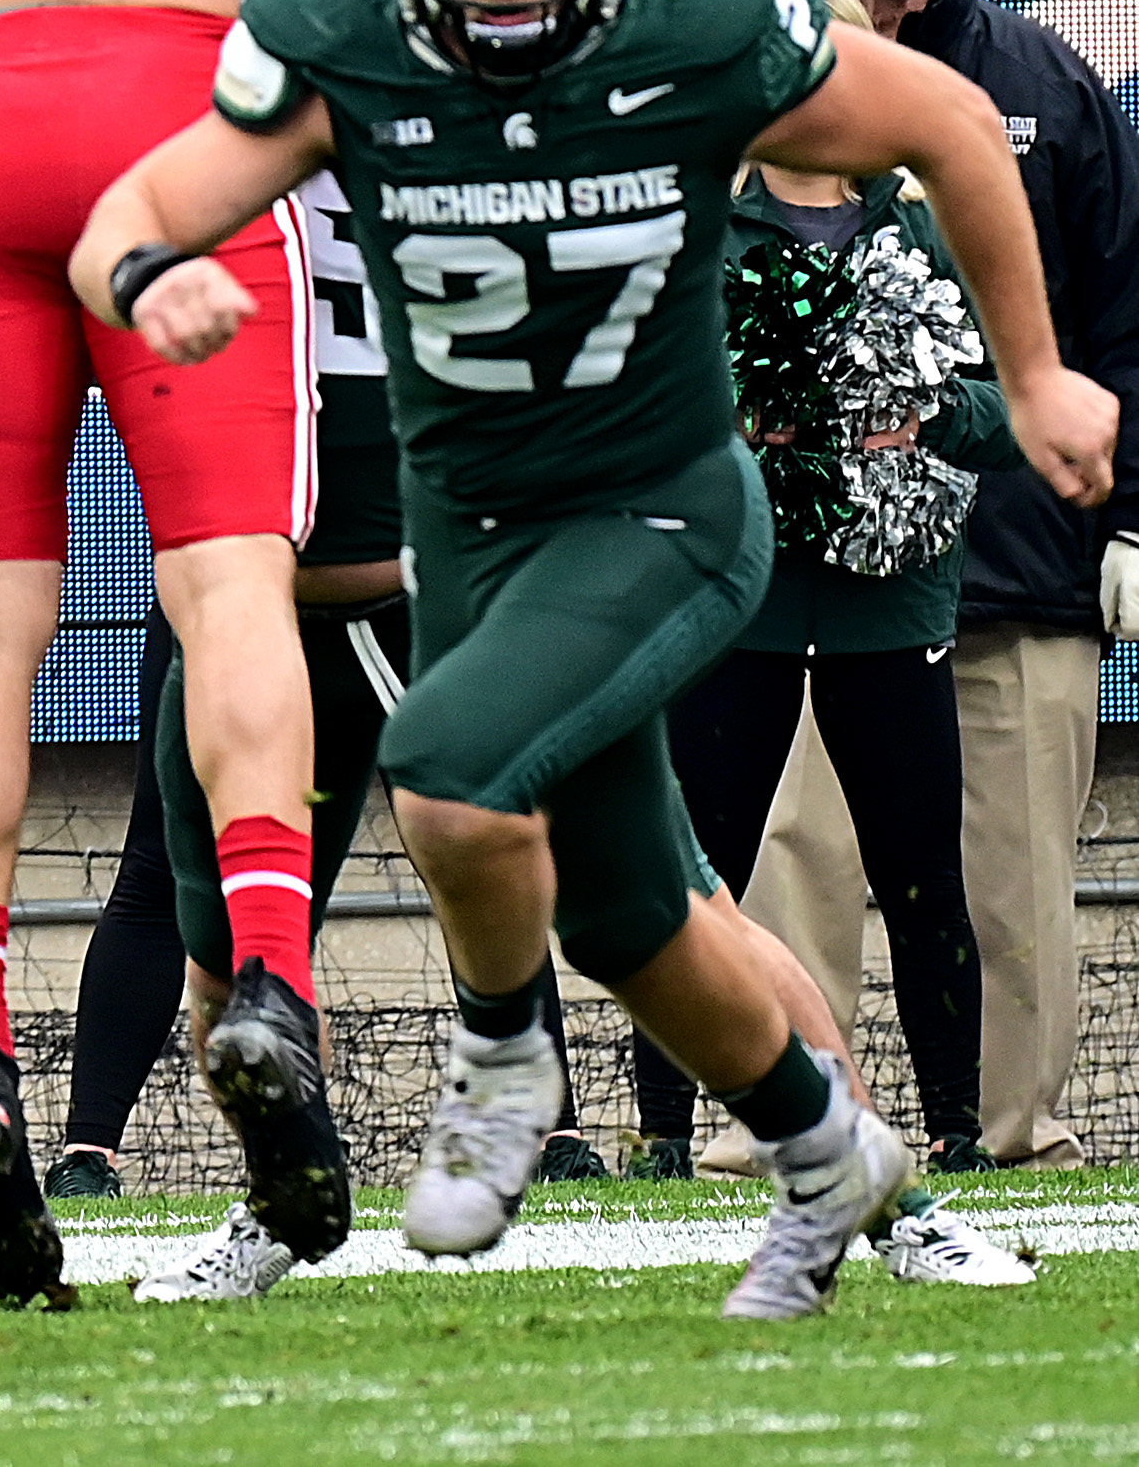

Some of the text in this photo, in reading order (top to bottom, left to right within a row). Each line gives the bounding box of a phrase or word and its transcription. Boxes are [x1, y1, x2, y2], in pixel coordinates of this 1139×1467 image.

[379, 163, 684, 226] MICHIGAN STATE
[392, 209, 687, 392] 27
